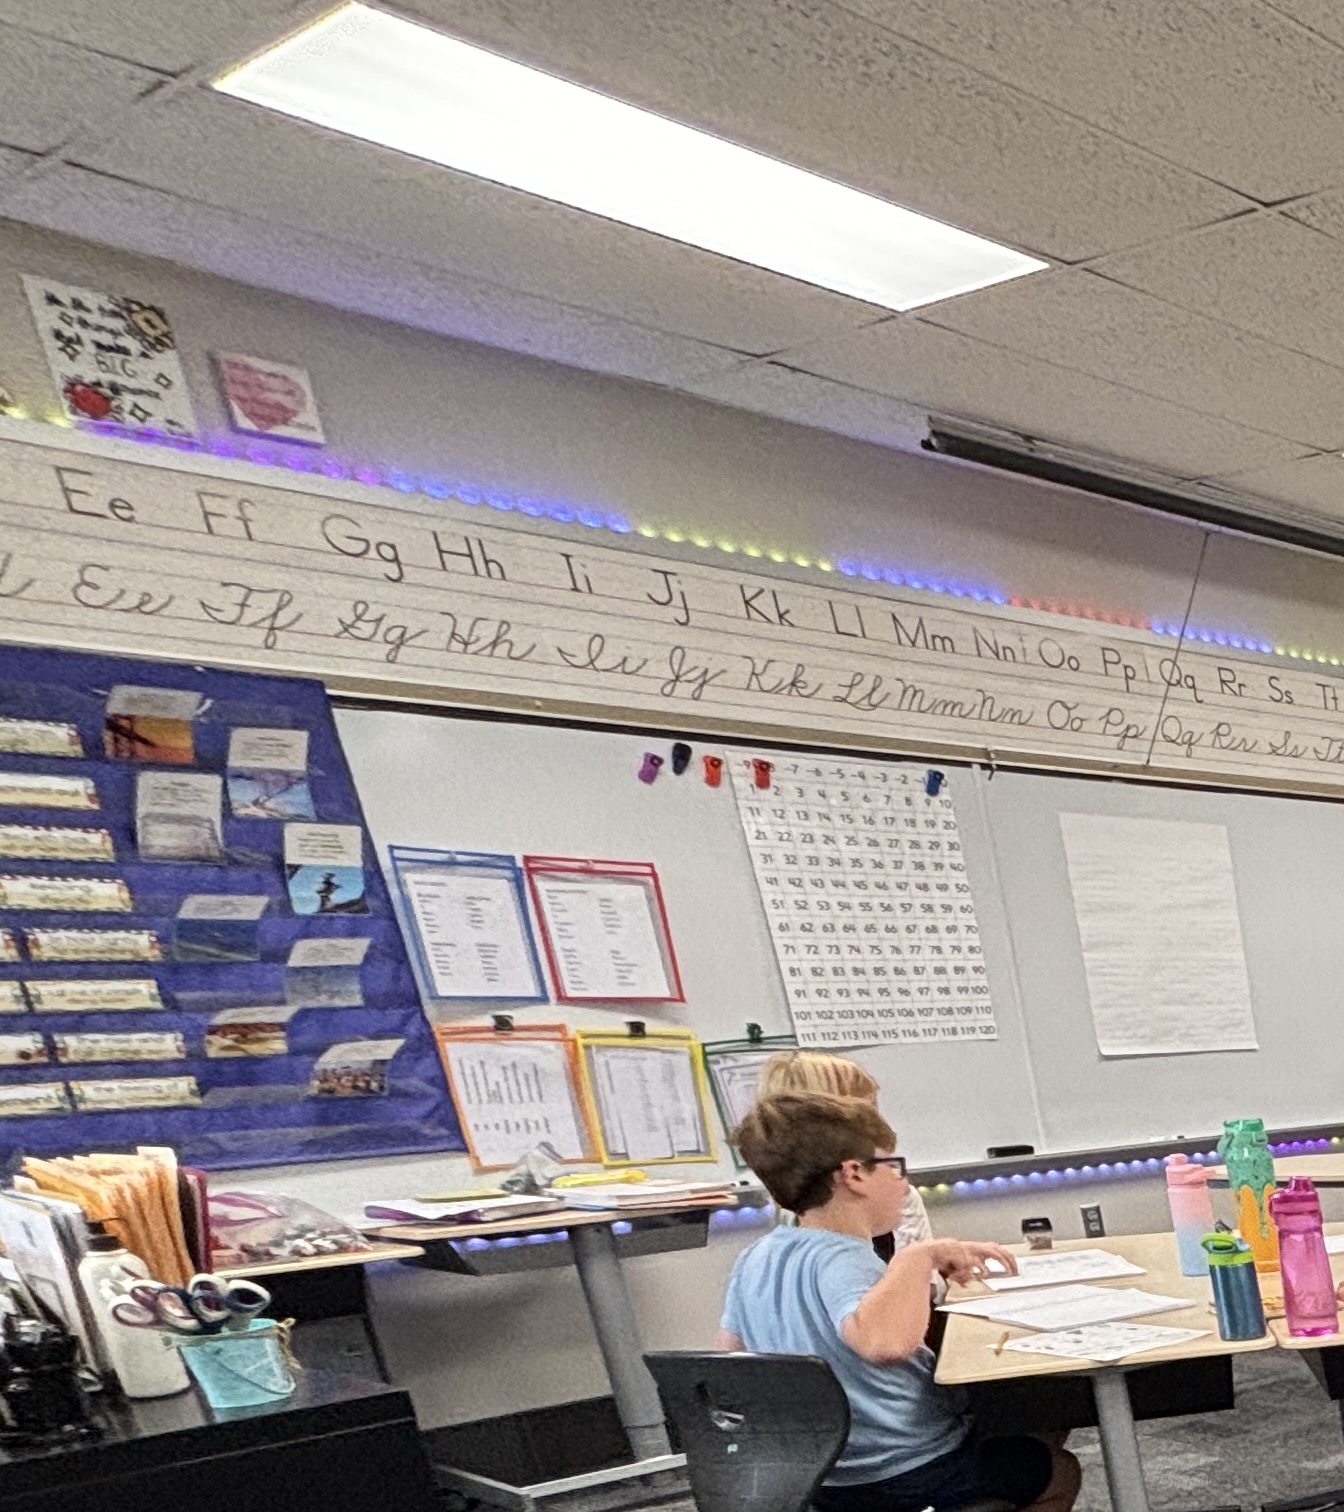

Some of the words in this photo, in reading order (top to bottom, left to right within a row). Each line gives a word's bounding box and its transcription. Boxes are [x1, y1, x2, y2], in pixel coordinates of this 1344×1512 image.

[54, 464, 136, 523] Ee
[196, 490, 258, 541] Ff
[321, 513, 404, 583] Gg
[432, 531, 507, 581] Hh
[560, 552, 594, 595] Ii
[647, 568, 690, 627] Jj
[739, 584, 796, 627] Kk
[828, 601, 867, 639] Ll
[891, 613, 955, 654] Mm
[972, 626, 1016, 663] Nn
[1038, 638, 1080, 671] Oo
[1101, 647, 1136, 692] Pp
[1159, 658, 1204, 704] Qq
[1217, 667, 1247, 697] Rr
[1268, 675, 1294, 705] Ss
[1315, 683, 1339, 711] Tt
[785, 763, 799, 774] -7
[806, 766, 822, 777] -6
[829, 768, 846, 780] -5
[851, 770, 866, 781] -4
[873, 772, 888, 784] -3
[894, 774, 909, 786] -2
[747, 806, 761, 817] 11
[771, 808, 786, 820] 12
[795, 809, 810, 822] 13
[816, 811, 832, 823] 14
[839, 813, 855, 825] 15
[861, 814, 877, 826] 16
[883, 816, 897, 827] 17
[903, 817, 917, 828] 18
[923, 819, 938, 829] 19
[942, 819, 958, 831] 20
[782, 943, 796, 955] 71
[804, 944, 820, 955] 72
[826, 944, 841, 955] 73
[847, 944, 862, 955] 74
[868, 944, 883, 956] 75
[889, 944, 903, 955] 76
[908, 944, 922, 955] 77
[928, 945, 944, 955] 78
[949, 944, 963, 955] 79
[967, 944, 982, 955] 80
[788, 966, 802, 977] 81
[810, 966, 825, 978] 82
[831, 966, 846, 977] 83
[851, 966, 867, 977] 84
[872, 966, 888, 977] 85
[892, 966, 907, 976] 86
[912, 965, 927, 976] 87
[933, 965, 948, 976] 88
[953, 965, 967, 976] 89
[971, 965, 986, 975] 90
[794, 988, 808, 999] 91
[814, 988, 830, 999] 92
[836, 988, 851, 998] 93
[856, 987, 871, 998] 94
[877, 987, 892, 998] 95
[897, 987, 912, 997] 96
[916, 986, 931, 996] 97
[936, 986, 952, 996] 98
[956, 985, 970, 995] 99
[970, 985, 989, 995] 100
[794, 1010, 812, 1021] 101
[815, 1009, 834, 1021] 102
[837, 1009, 855, 1020] 103
[856, 1008, 874, 1019] 104
[876, 1008, 895, 1019] 105
[896, 1007, 915, 1018] 106
[917, 1006, 933, 1017] 107
[936, 1006, 954, 1017] 108
[956, 1006, 973, 1016] 109
[974, 1005, 992, 1015] 110
[800, 1032, 817, 1042] 111
[820, 1031, 839, 1041] 112
[841, 1030, 859, 1041] 113
[861, 1030, 880, 1040] 114
[881, 1028, 899, 1039] 115
[901, 1028, 920, 1038] 116
[921, 1027, 939, 1037] 117
[941, 1026, 959, 1037] 118
[960, 1025, 977, 1035] 119
[978, 1025, 996, 1035] 120
